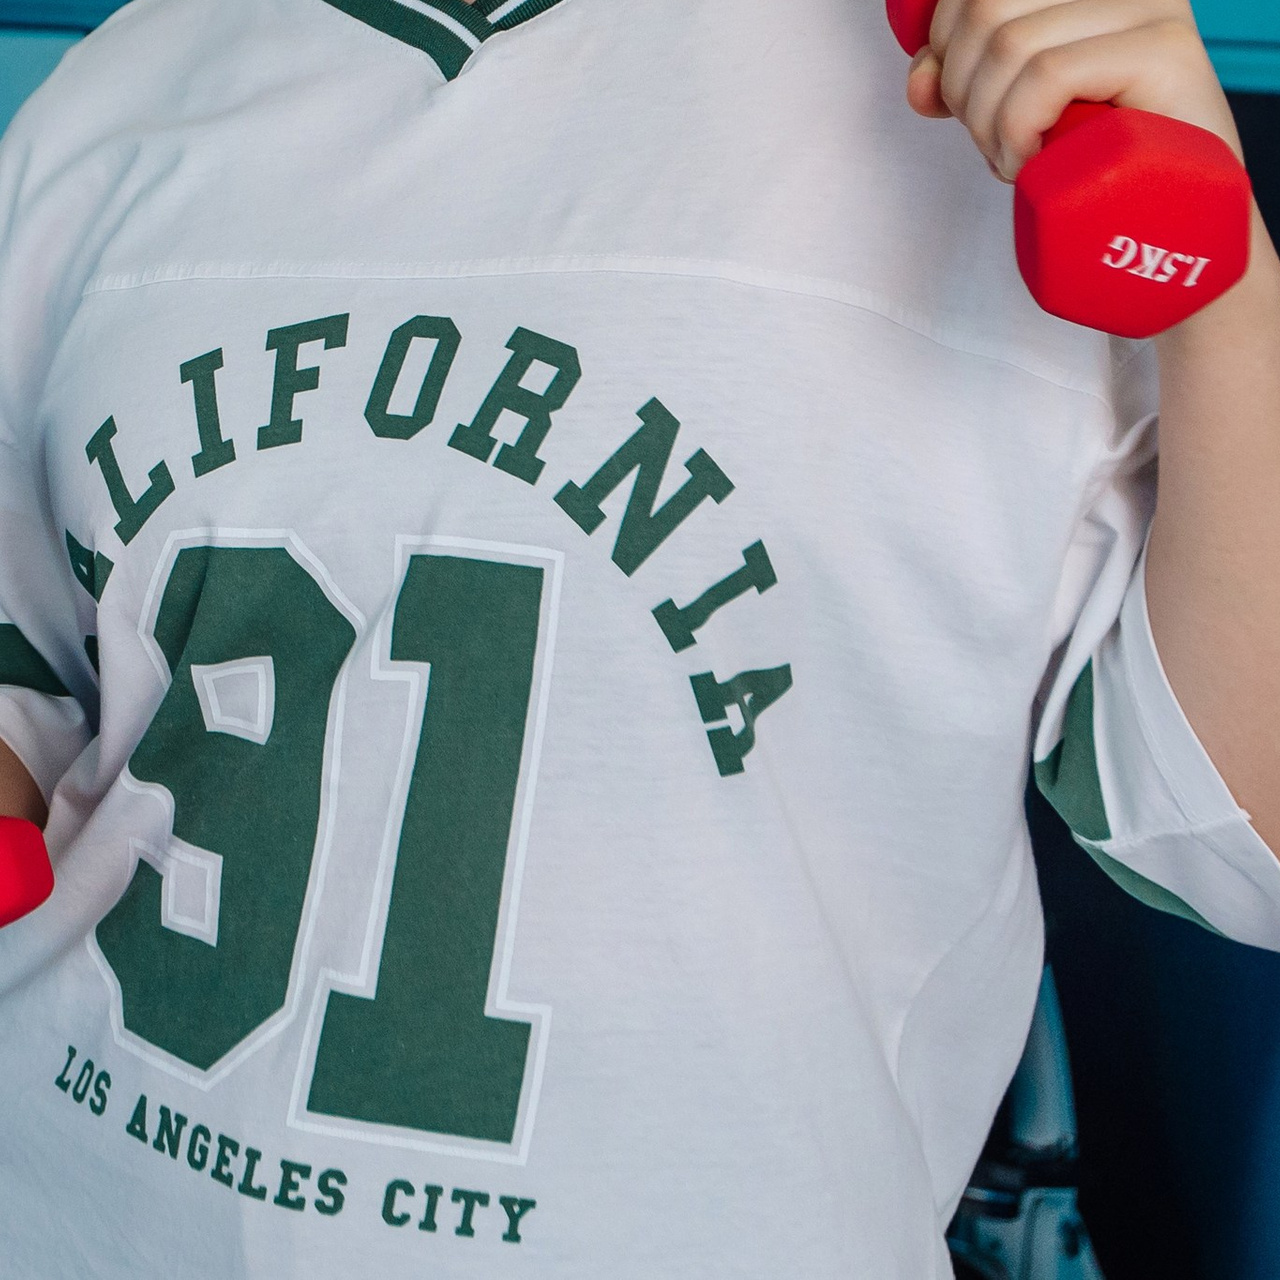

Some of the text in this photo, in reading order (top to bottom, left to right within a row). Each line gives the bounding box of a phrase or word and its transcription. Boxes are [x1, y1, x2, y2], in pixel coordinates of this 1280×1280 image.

[88, 530, 562, 1160] 91
[54, 1045, 537, 1244] LOS ANGELES CITY
